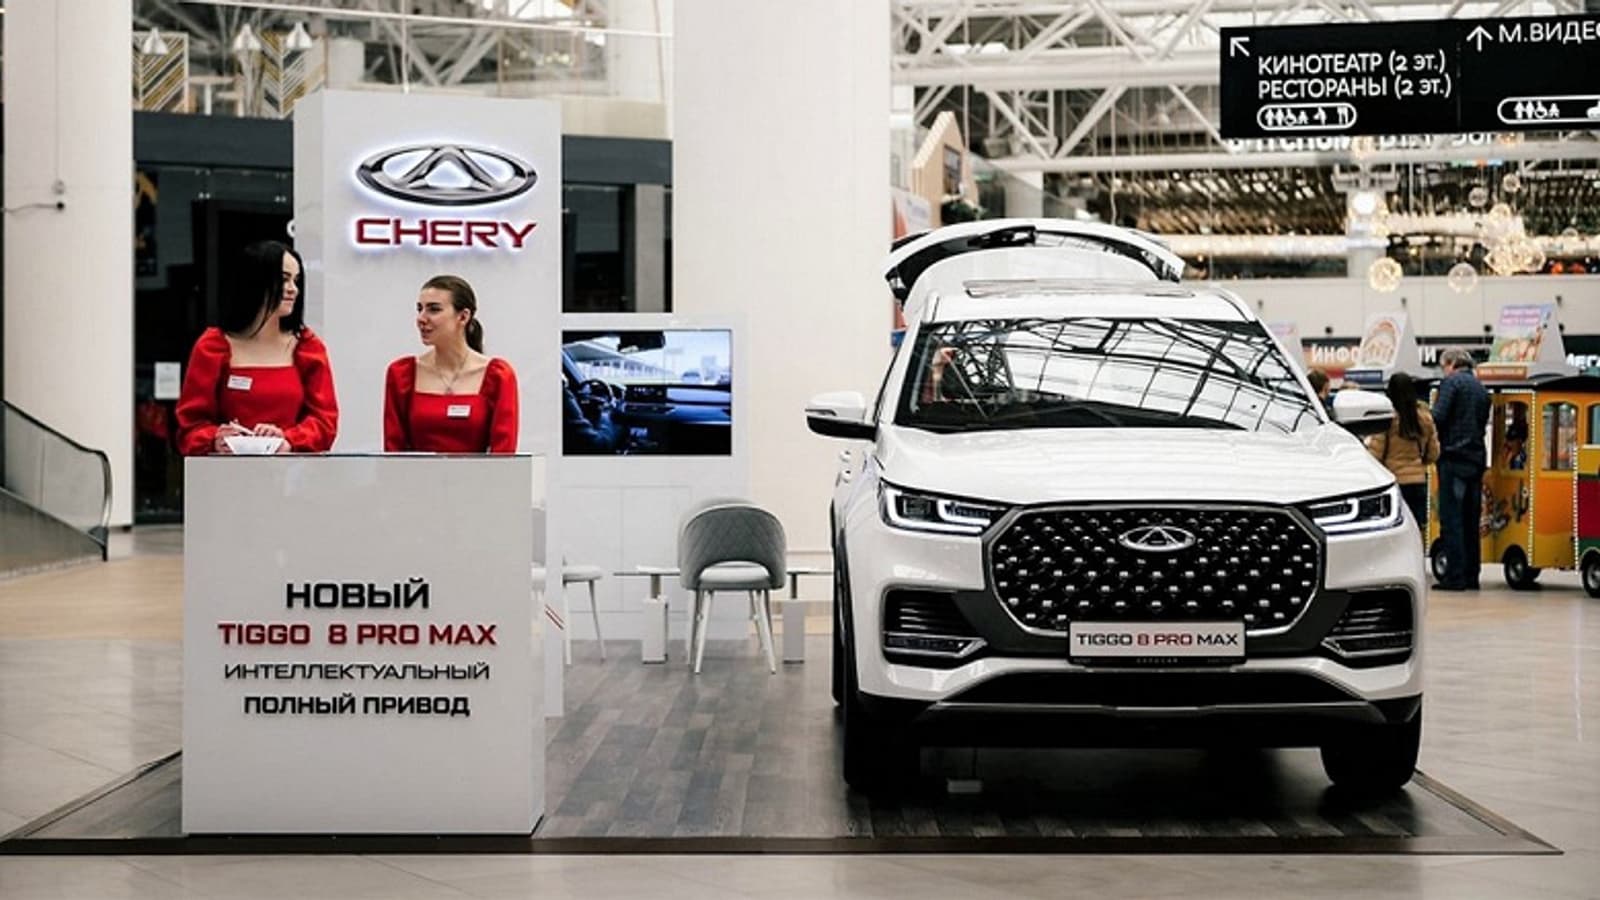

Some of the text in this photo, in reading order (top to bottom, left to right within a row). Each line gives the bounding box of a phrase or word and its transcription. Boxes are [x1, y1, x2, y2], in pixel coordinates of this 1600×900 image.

[1499, 20, 1600, 45] М.ВИДЕ
[1258, 53, 1383, 75] КИНОТЕАТР
[1389, 49, 1408, 75] (2
[1258, 76, 1387, 99] РЕСТОРАНЫ
[1394, 74, 1414, 99] (2
[356, 218, 537, 248] CHERY
[286, 578, 429, 609] НОВЫЙ
[218, 624, 497, 645] TIGGO 8 PRO MAX
[1076, 633, 1238, 646] TIGGO 8 PRO MAX
[224, 662, 490, 680] ИНТЕЛЛЕКТУАЛЬНЫЙ
[244, 693, 470, 717] ПОЛНЫЙ ПРИВОД
